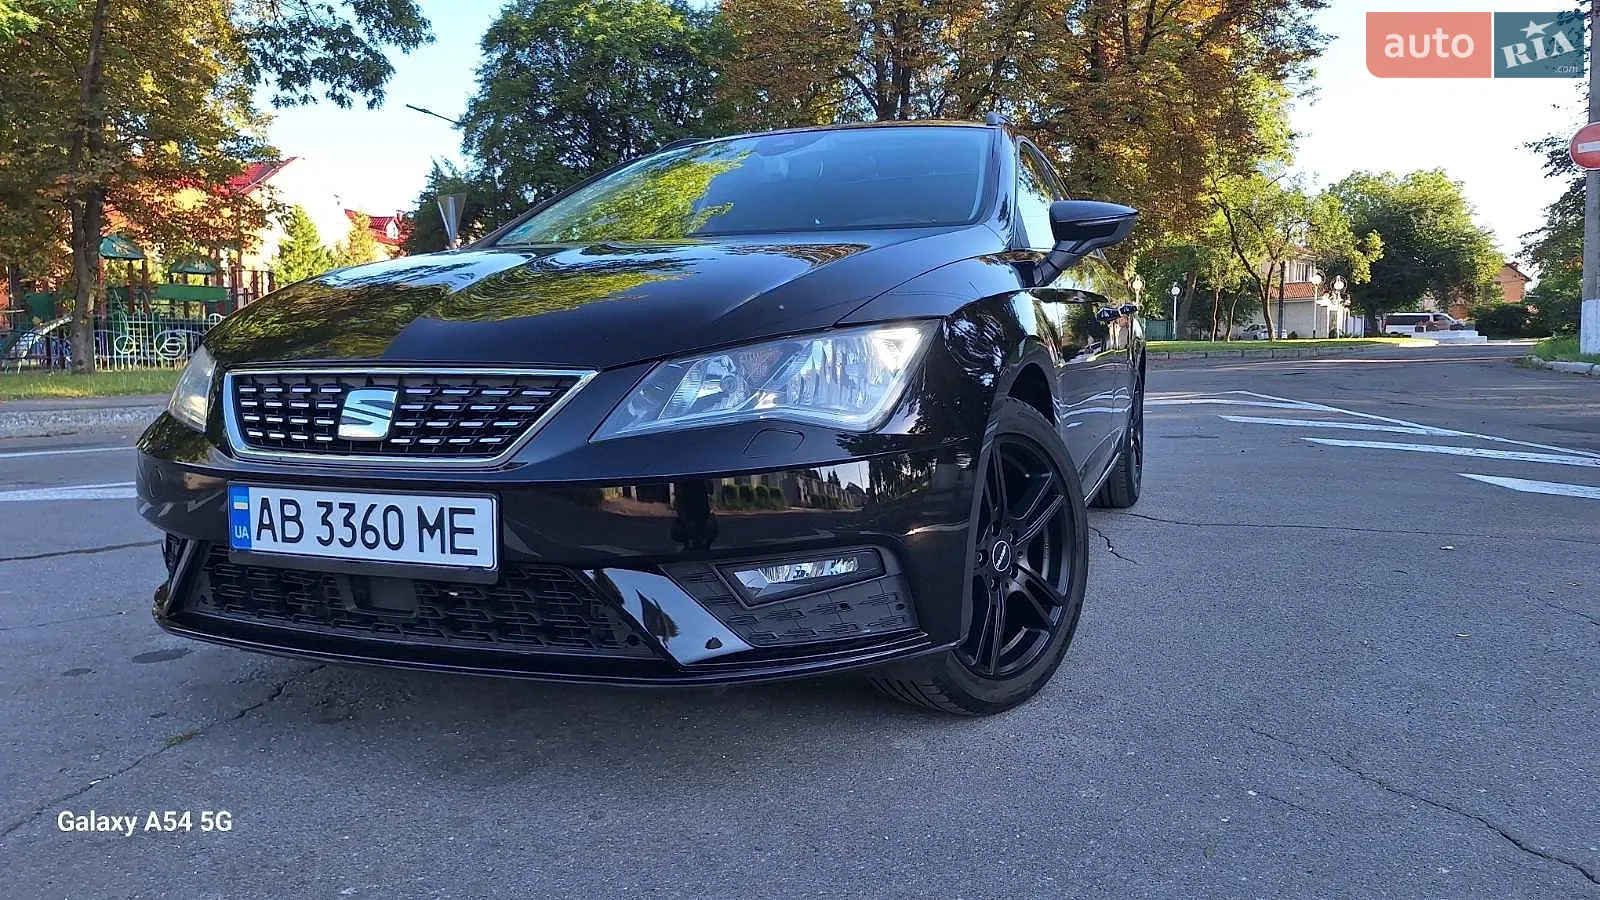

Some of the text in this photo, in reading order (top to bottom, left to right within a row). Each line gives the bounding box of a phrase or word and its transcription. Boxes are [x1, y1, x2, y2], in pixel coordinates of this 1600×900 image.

[234, 525, 250, 540] UA
[255, 497, 479, 556] AB 3360 ME
